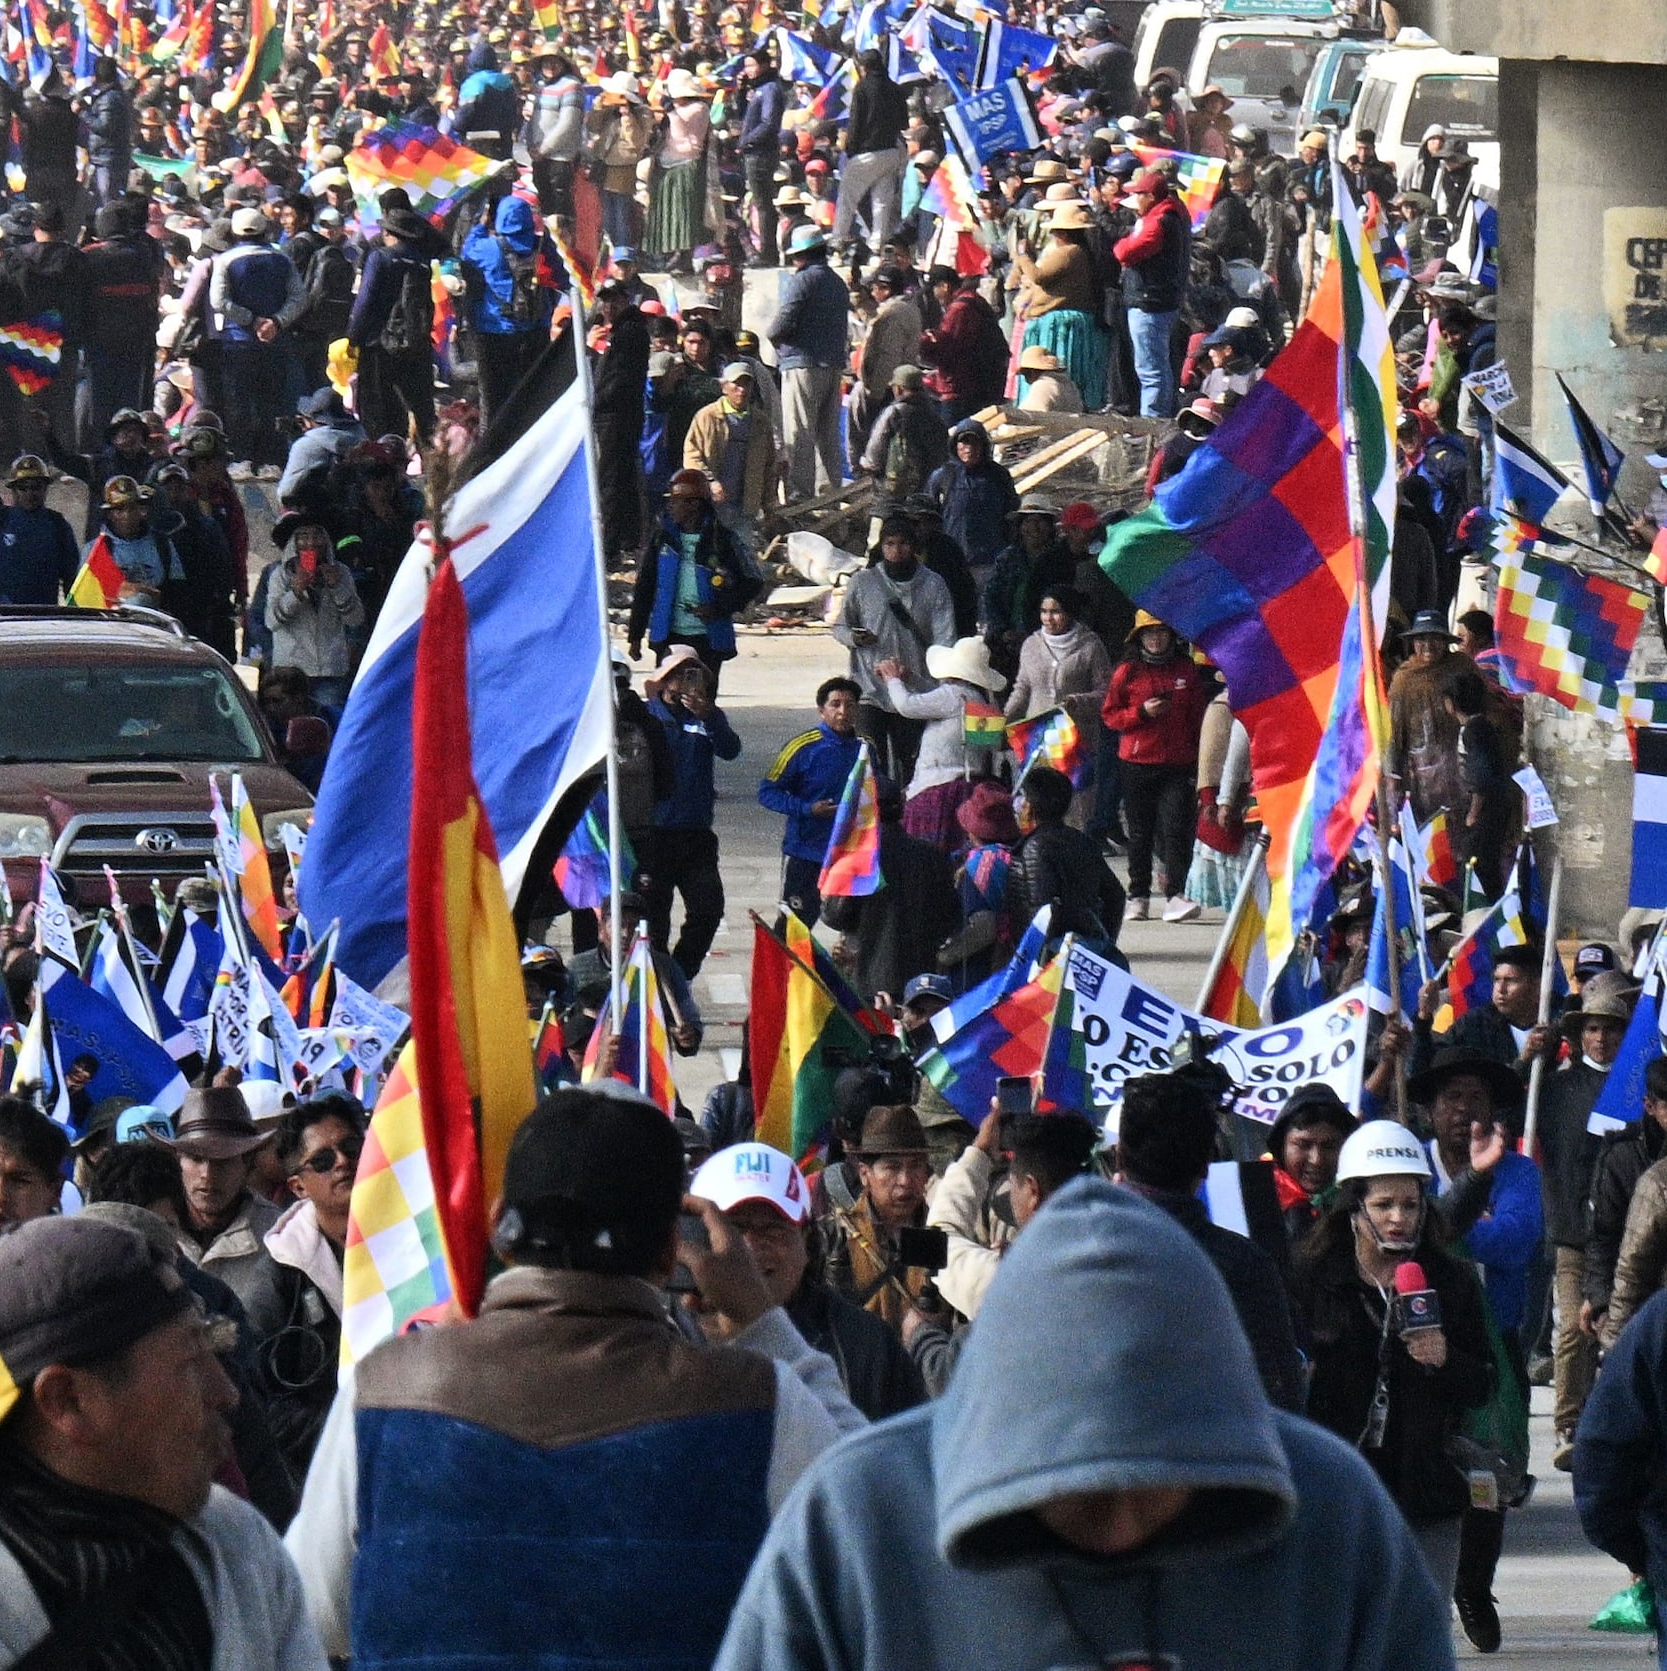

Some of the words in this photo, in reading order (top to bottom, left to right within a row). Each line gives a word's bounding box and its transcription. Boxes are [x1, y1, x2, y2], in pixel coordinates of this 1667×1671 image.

[964, 92, 1006, 122] MAS
[1248, 1039, 1356, 1083] SOLO
[1367, 1146, 1420, 1160] PRENSA
